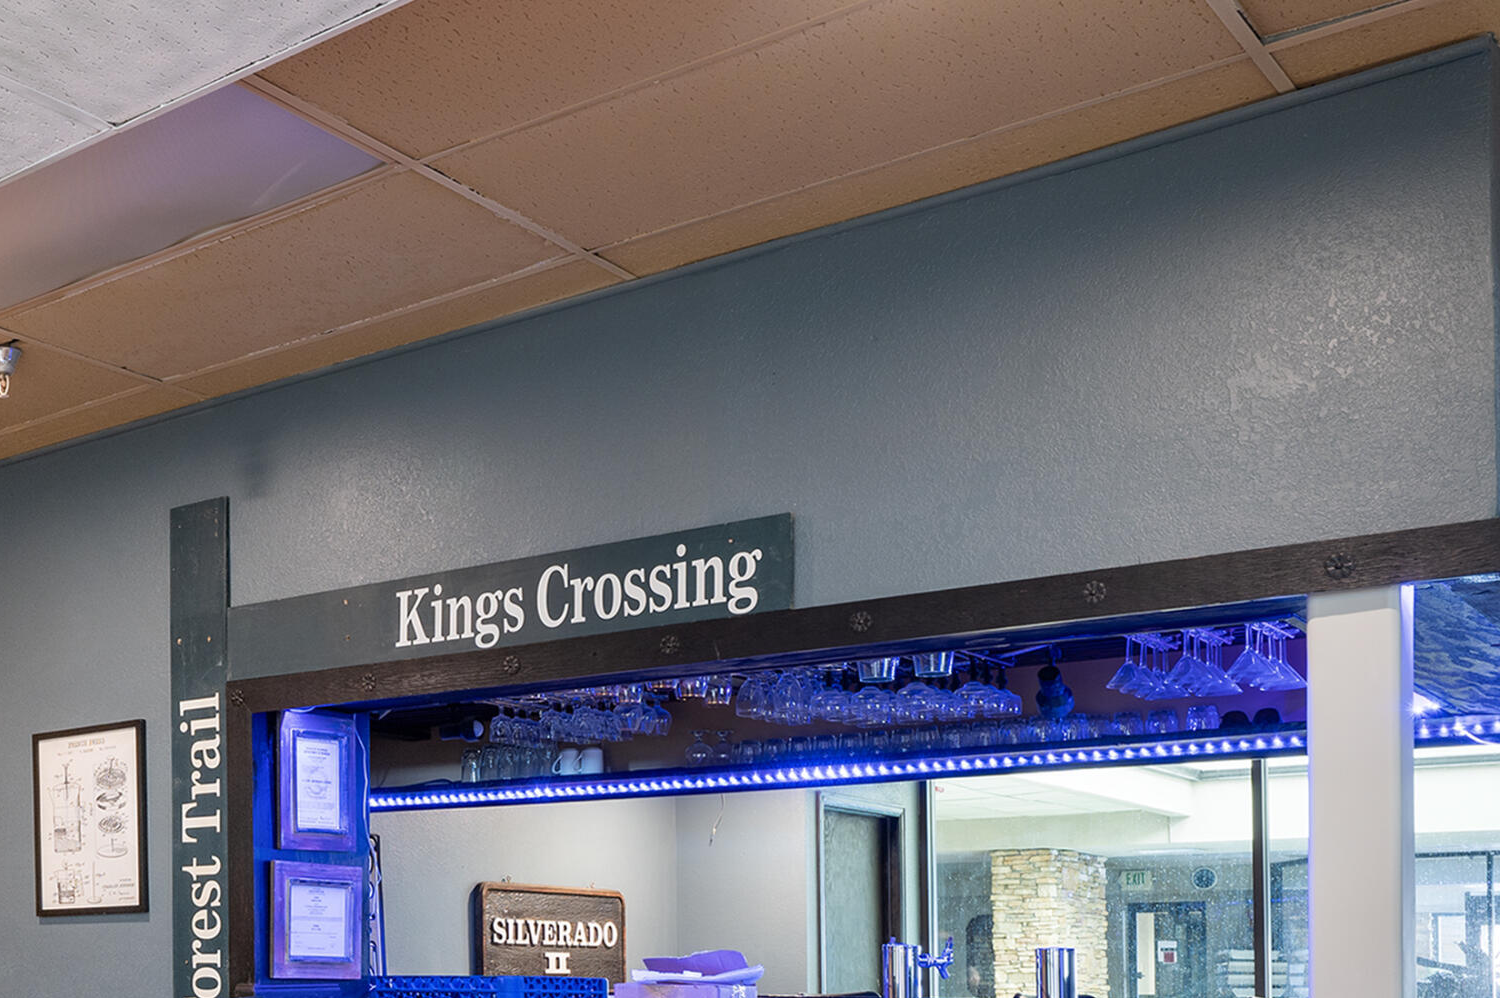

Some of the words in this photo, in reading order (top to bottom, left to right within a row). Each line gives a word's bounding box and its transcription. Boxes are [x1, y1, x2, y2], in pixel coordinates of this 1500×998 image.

[394, 583, 525, 649] Kings
[536, 543, 763, 629] Crossing
[179, 691, 221, 843] Trail
[1126, 872, 1145, 885] EXIT
[491, 917, 618, 948] SILVERADO
[544, 951, 572, 975] II
